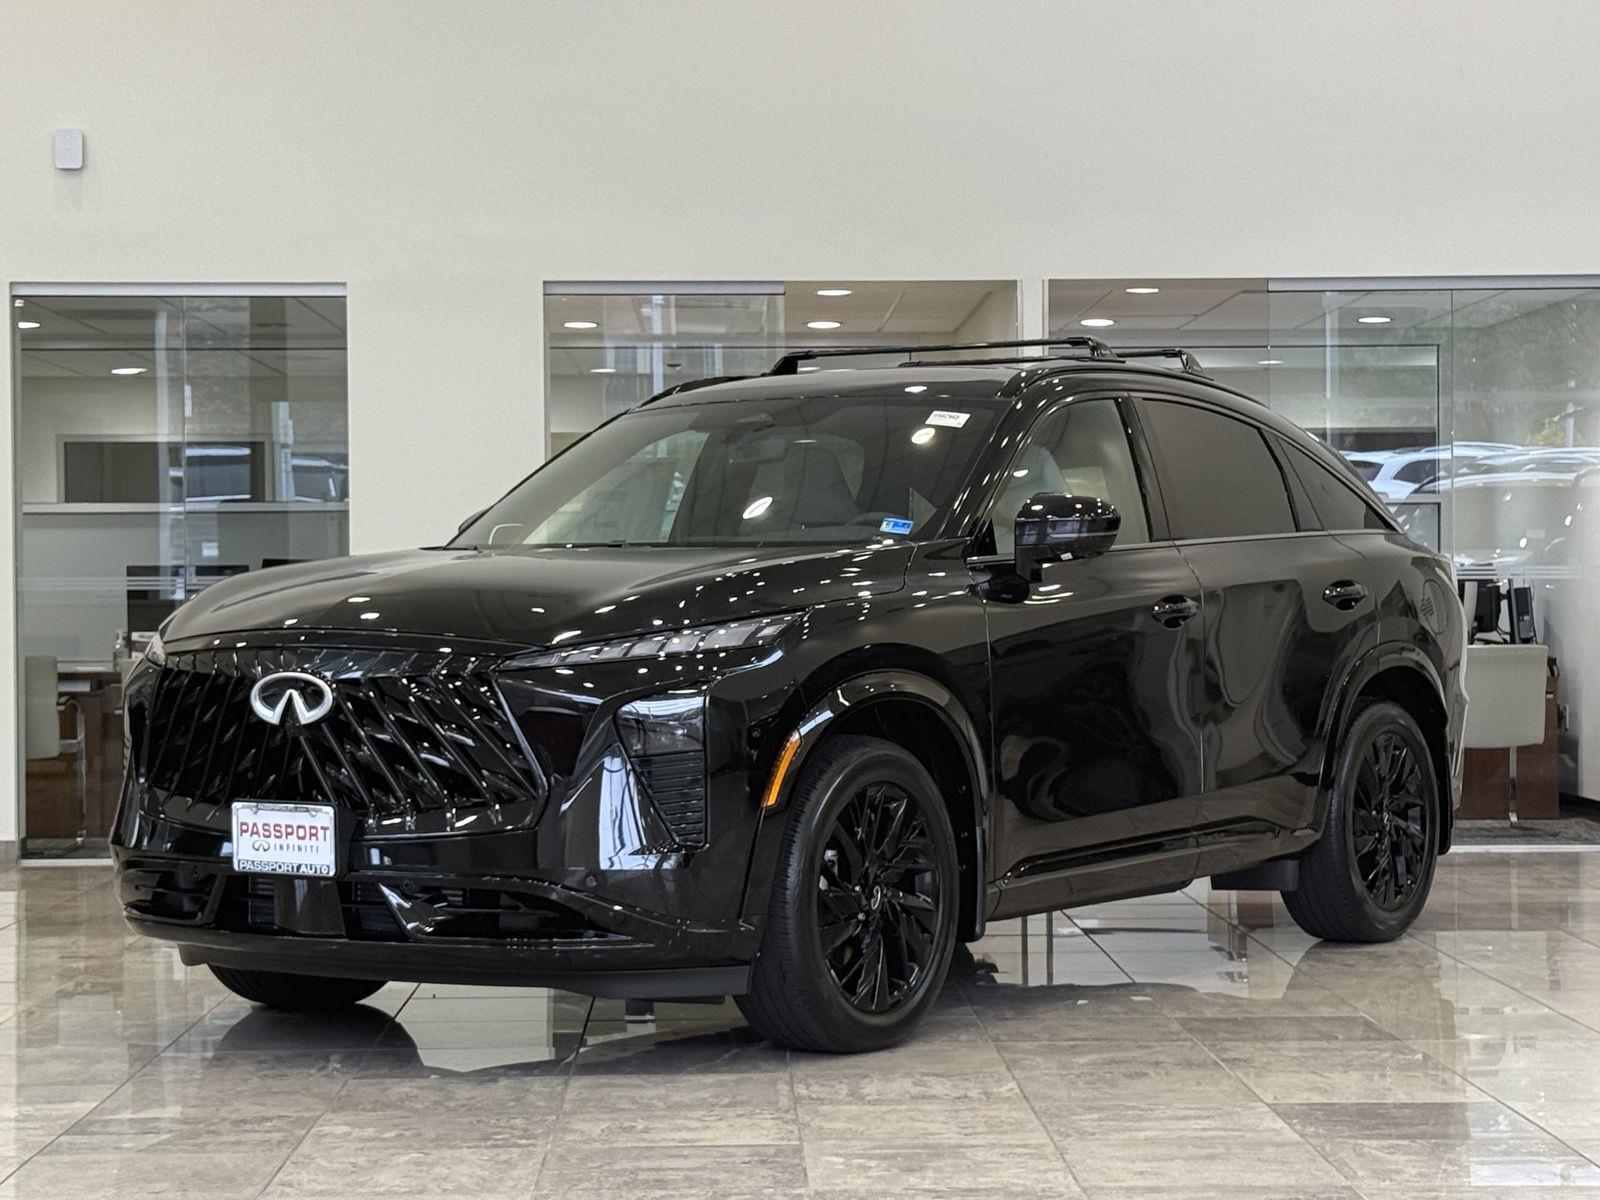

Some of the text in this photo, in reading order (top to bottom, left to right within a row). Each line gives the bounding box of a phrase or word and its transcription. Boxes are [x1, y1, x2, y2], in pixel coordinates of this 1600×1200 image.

[240, 822, 330, 842] PASSPORT
[274, 843, 319, 853] INFINITI
[240, 860, 329, 874] PASSPORT AUTO
